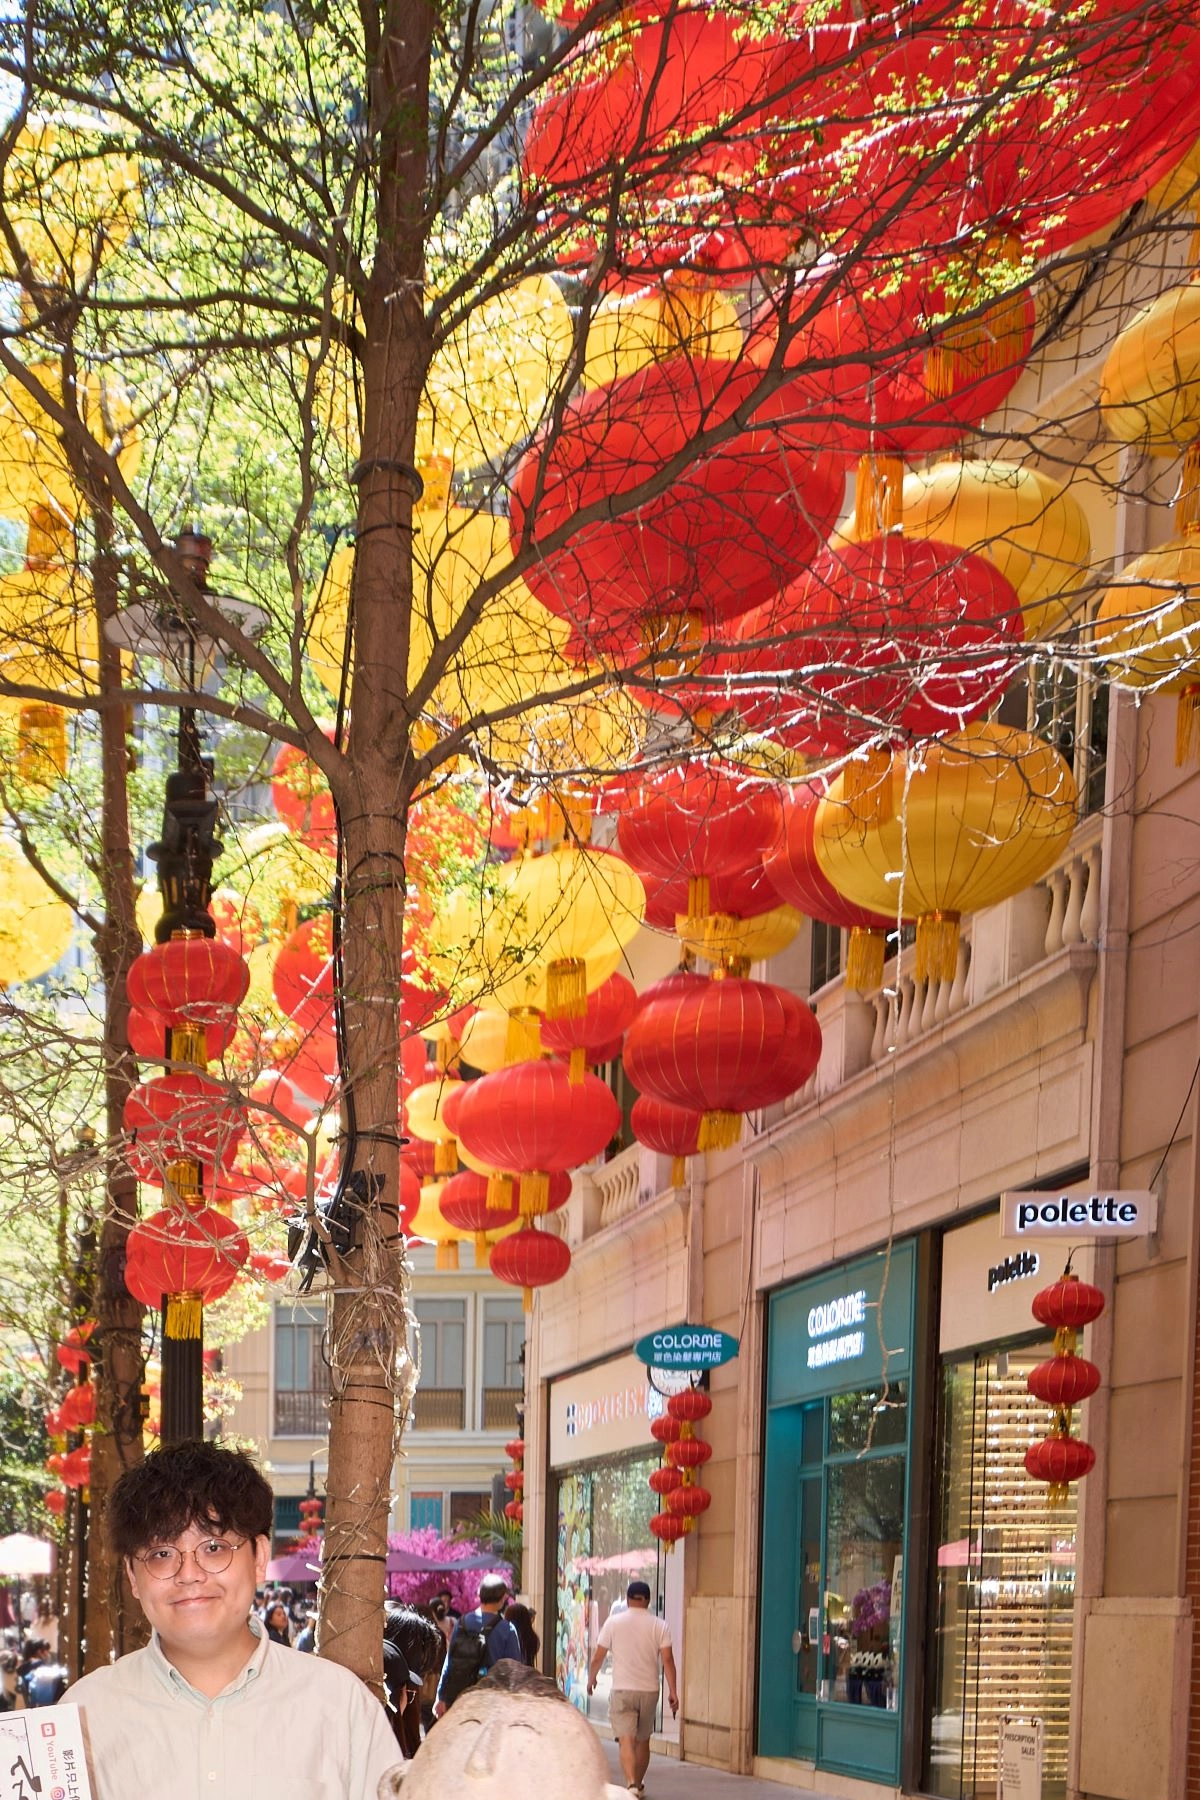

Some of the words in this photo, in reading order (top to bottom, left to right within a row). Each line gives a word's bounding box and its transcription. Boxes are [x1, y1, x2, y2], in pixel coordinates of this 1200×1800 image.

[1017, 1197, 1138, 1230] polette
[988, 1250, 1039, 1292] polette
[653, 1333, 722, 1349] COLORME
[1004, 1733, 1036, 1745] PRESCRIPTION
[1021, 1746, 1036, 1756] SALES
[46, 1741, 58, 1781] YouTube
